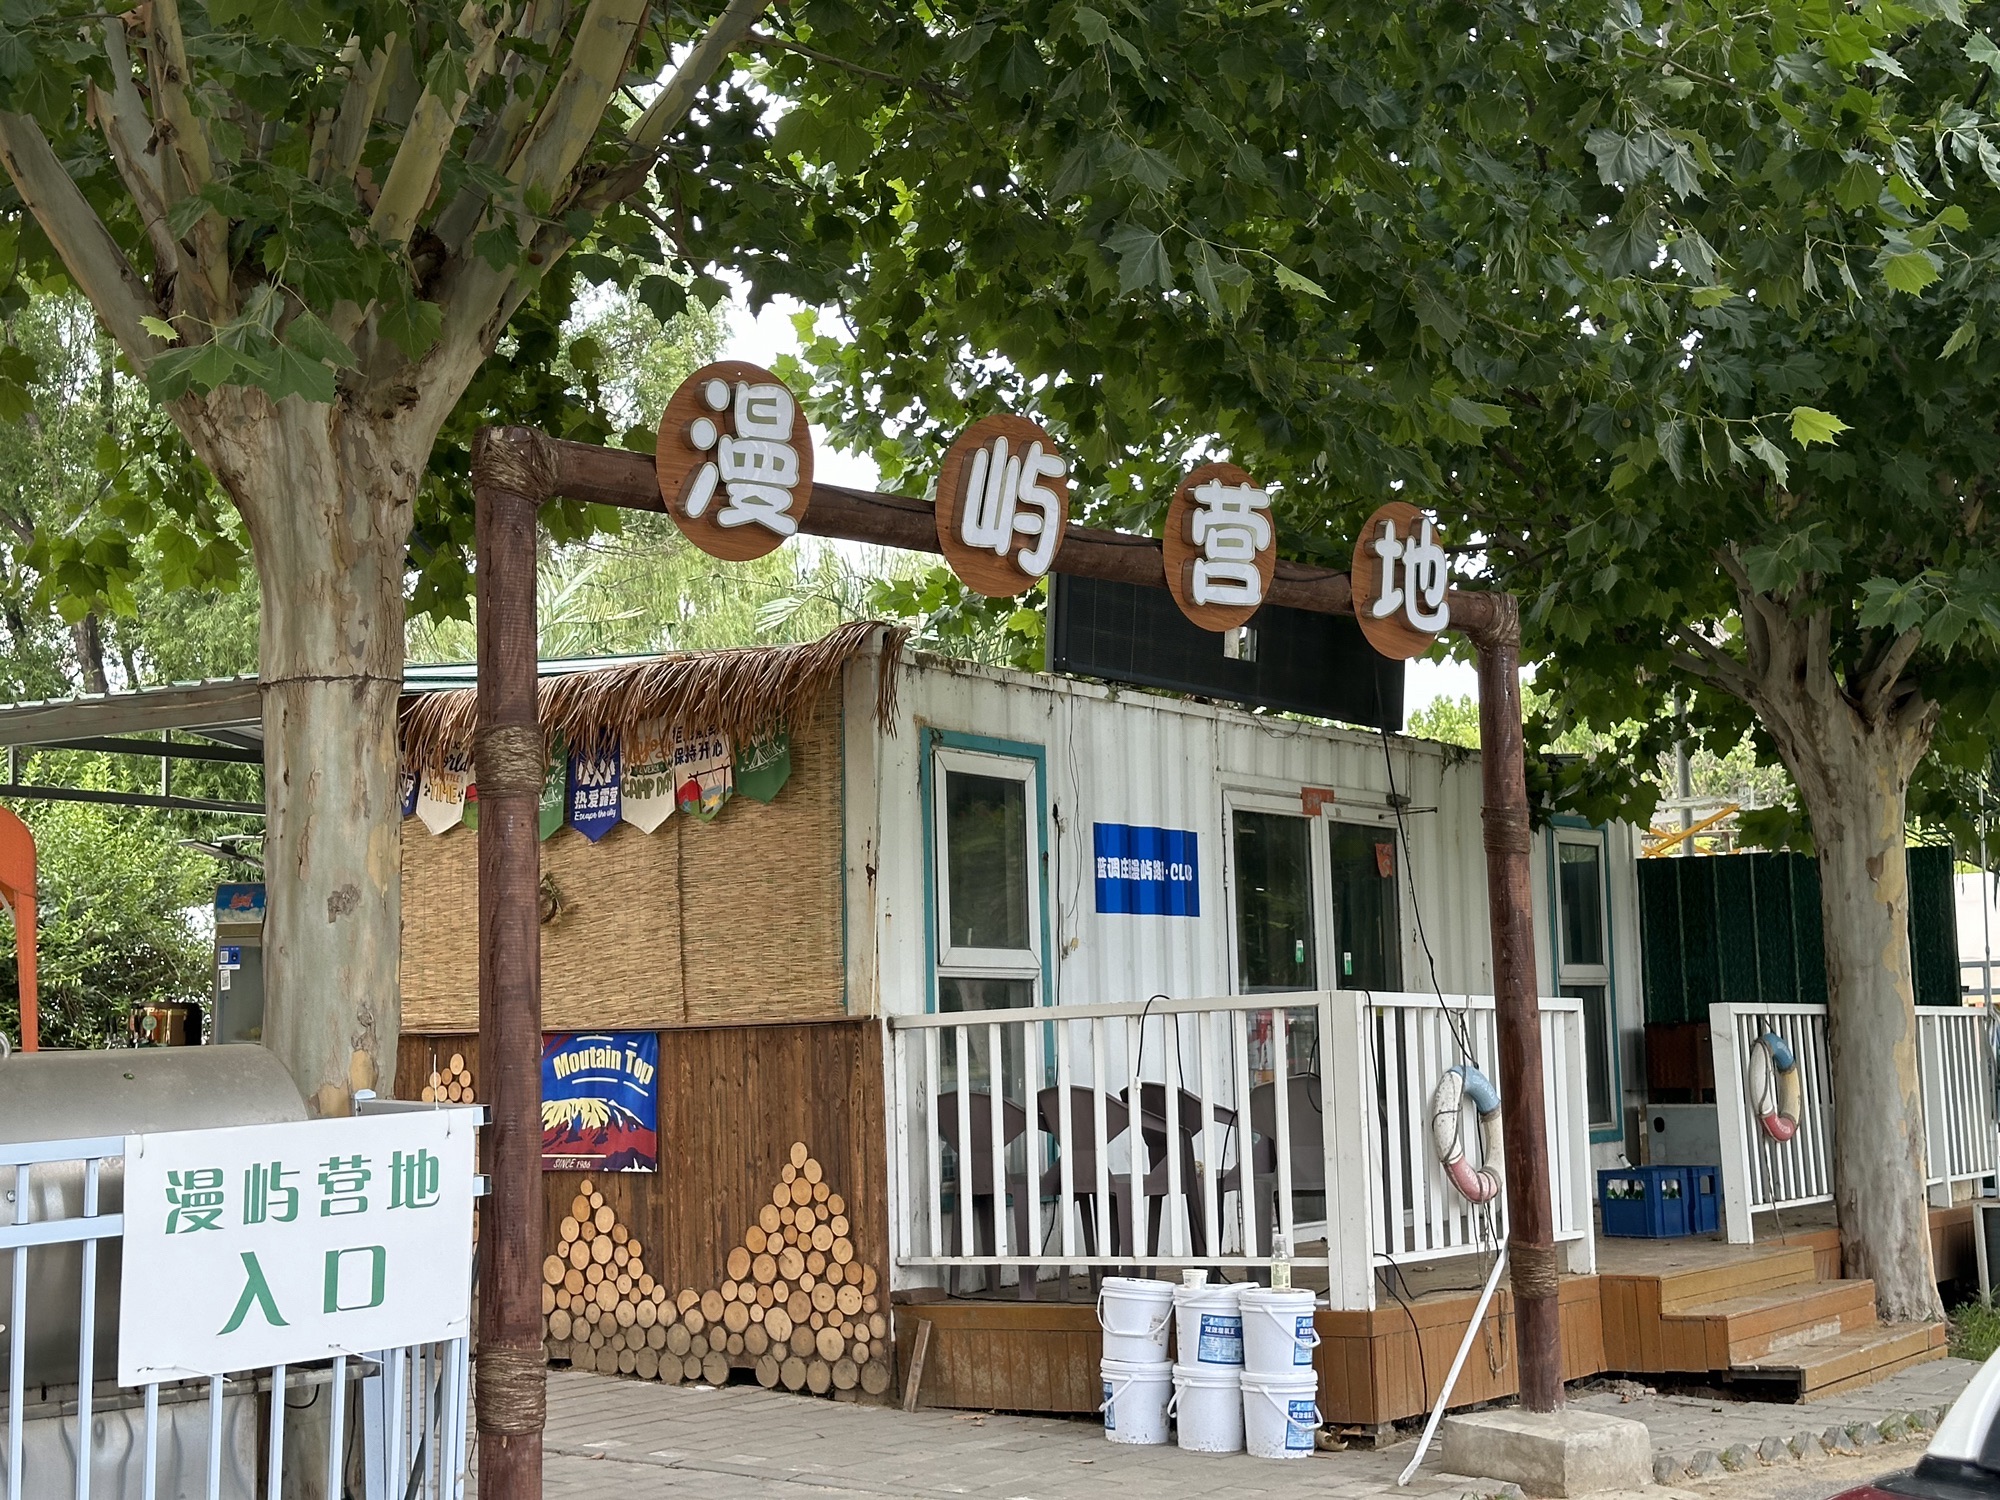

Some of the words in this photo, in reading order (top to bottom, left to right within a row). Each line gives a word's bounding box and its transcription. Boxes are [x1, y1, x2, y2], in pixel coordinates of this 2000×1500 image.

[684, 376, 1450, 634] 漫屿营地
[674, 739, 723, 766] 保持开心
[429, 780, 459, 805] TIME
[574, 786, 618, 810] 热爱露营
[621, 776, 655, 800] CAMP
[656, 769, 674, 798] DAY
[574, 811, 597, 821] Escape
[597, 809, 607, 818] the
[552, 1045, 622, 1080] Moutain
[625, 1048, 655, 1086] Top
[553, 1158, 576, 1169] SINCE
[164, 1147, 441, 1236] 漫屿营地
[217, 1245, 387, 1336] 入口
